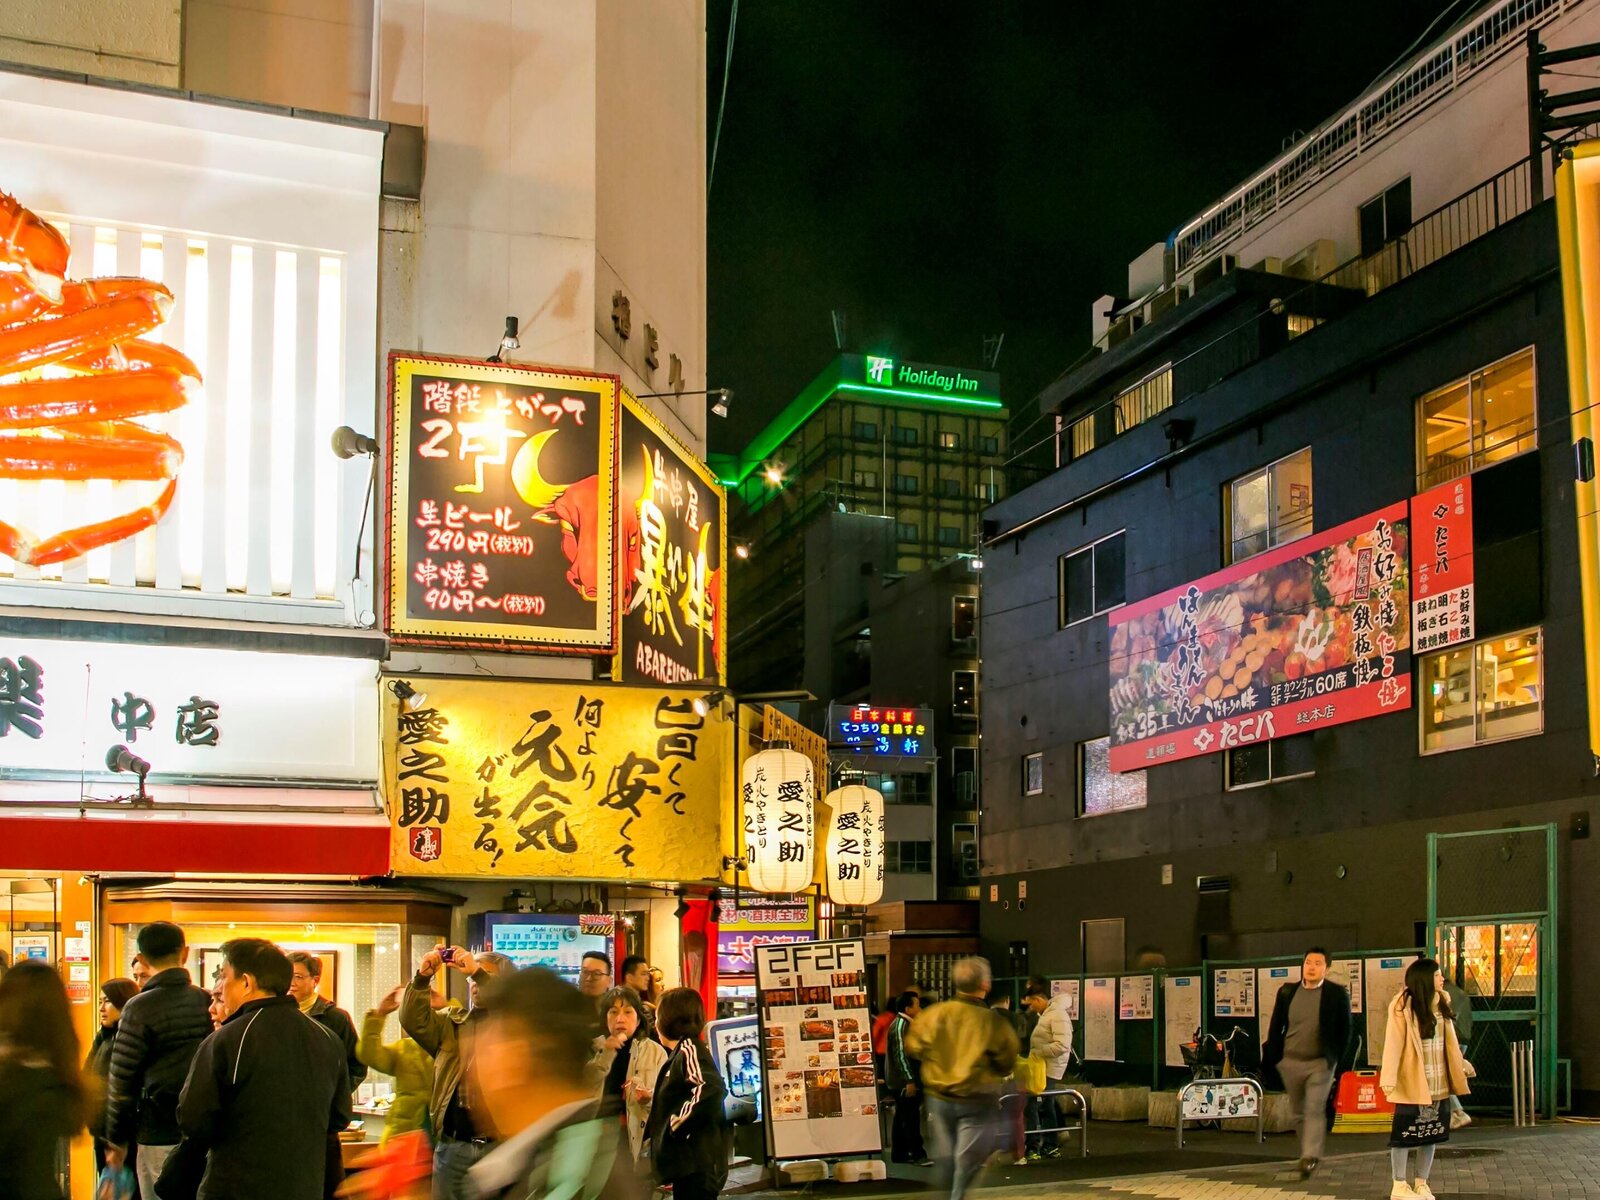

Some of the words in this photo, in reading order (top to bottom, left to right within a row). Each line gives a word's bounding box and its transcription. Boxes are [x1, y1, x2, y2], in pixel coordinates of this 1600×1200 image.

[422, 381, 587, 425] 階段上がって
[899, 366, 954, 391] Holiday
[956, 373, 978, 391] Inn
[417, 500, 520, 531] 生ビール
[414, 559, 489, 590] 串焼き
[1435, 526, 1450, 575] たこ八
[1417, 600, 1428, 650] 鉄板焼
[1428, 598, 1437, 648] ねぎ焼
[1438, 594, 1449, 644] 明石焼
[1449, 592, 1459, 641] たこ焼
[1459, 588, 1470, 639] お好み焼
[1352, 604, 1378, 687] 鉄板焼
[1271, 685, 1282, 697] 2F
[1284, 678, 1314, 694] カウンター
[1271, 695, 1282, 707] 3F
[1284, 687, 1315, 704] テーブル
[1316, 671, 1348, 693] 60席
[112, 691, 222, 746] 中店
[1219, 710, 1275, 749] たこ八
[1296, 704, 1336, 724] 総本店
[397, 708, 450, 827] 愛之助
[575, 695, 605, 791] 何より
[655, 695, 705, 815] 旨くて
[508, 710, 577, 853] 元気
[598, 751, 661, 867] 安くて
[754, 767, 767, 849] 炭火やきとり
[777, 780, 804, 862] 愛之助
[837, 812, 861, 880] 愛之助
[861, 800, 873, 868] 炭火やきとり
[767, 943, 854, 974] 2F2F
